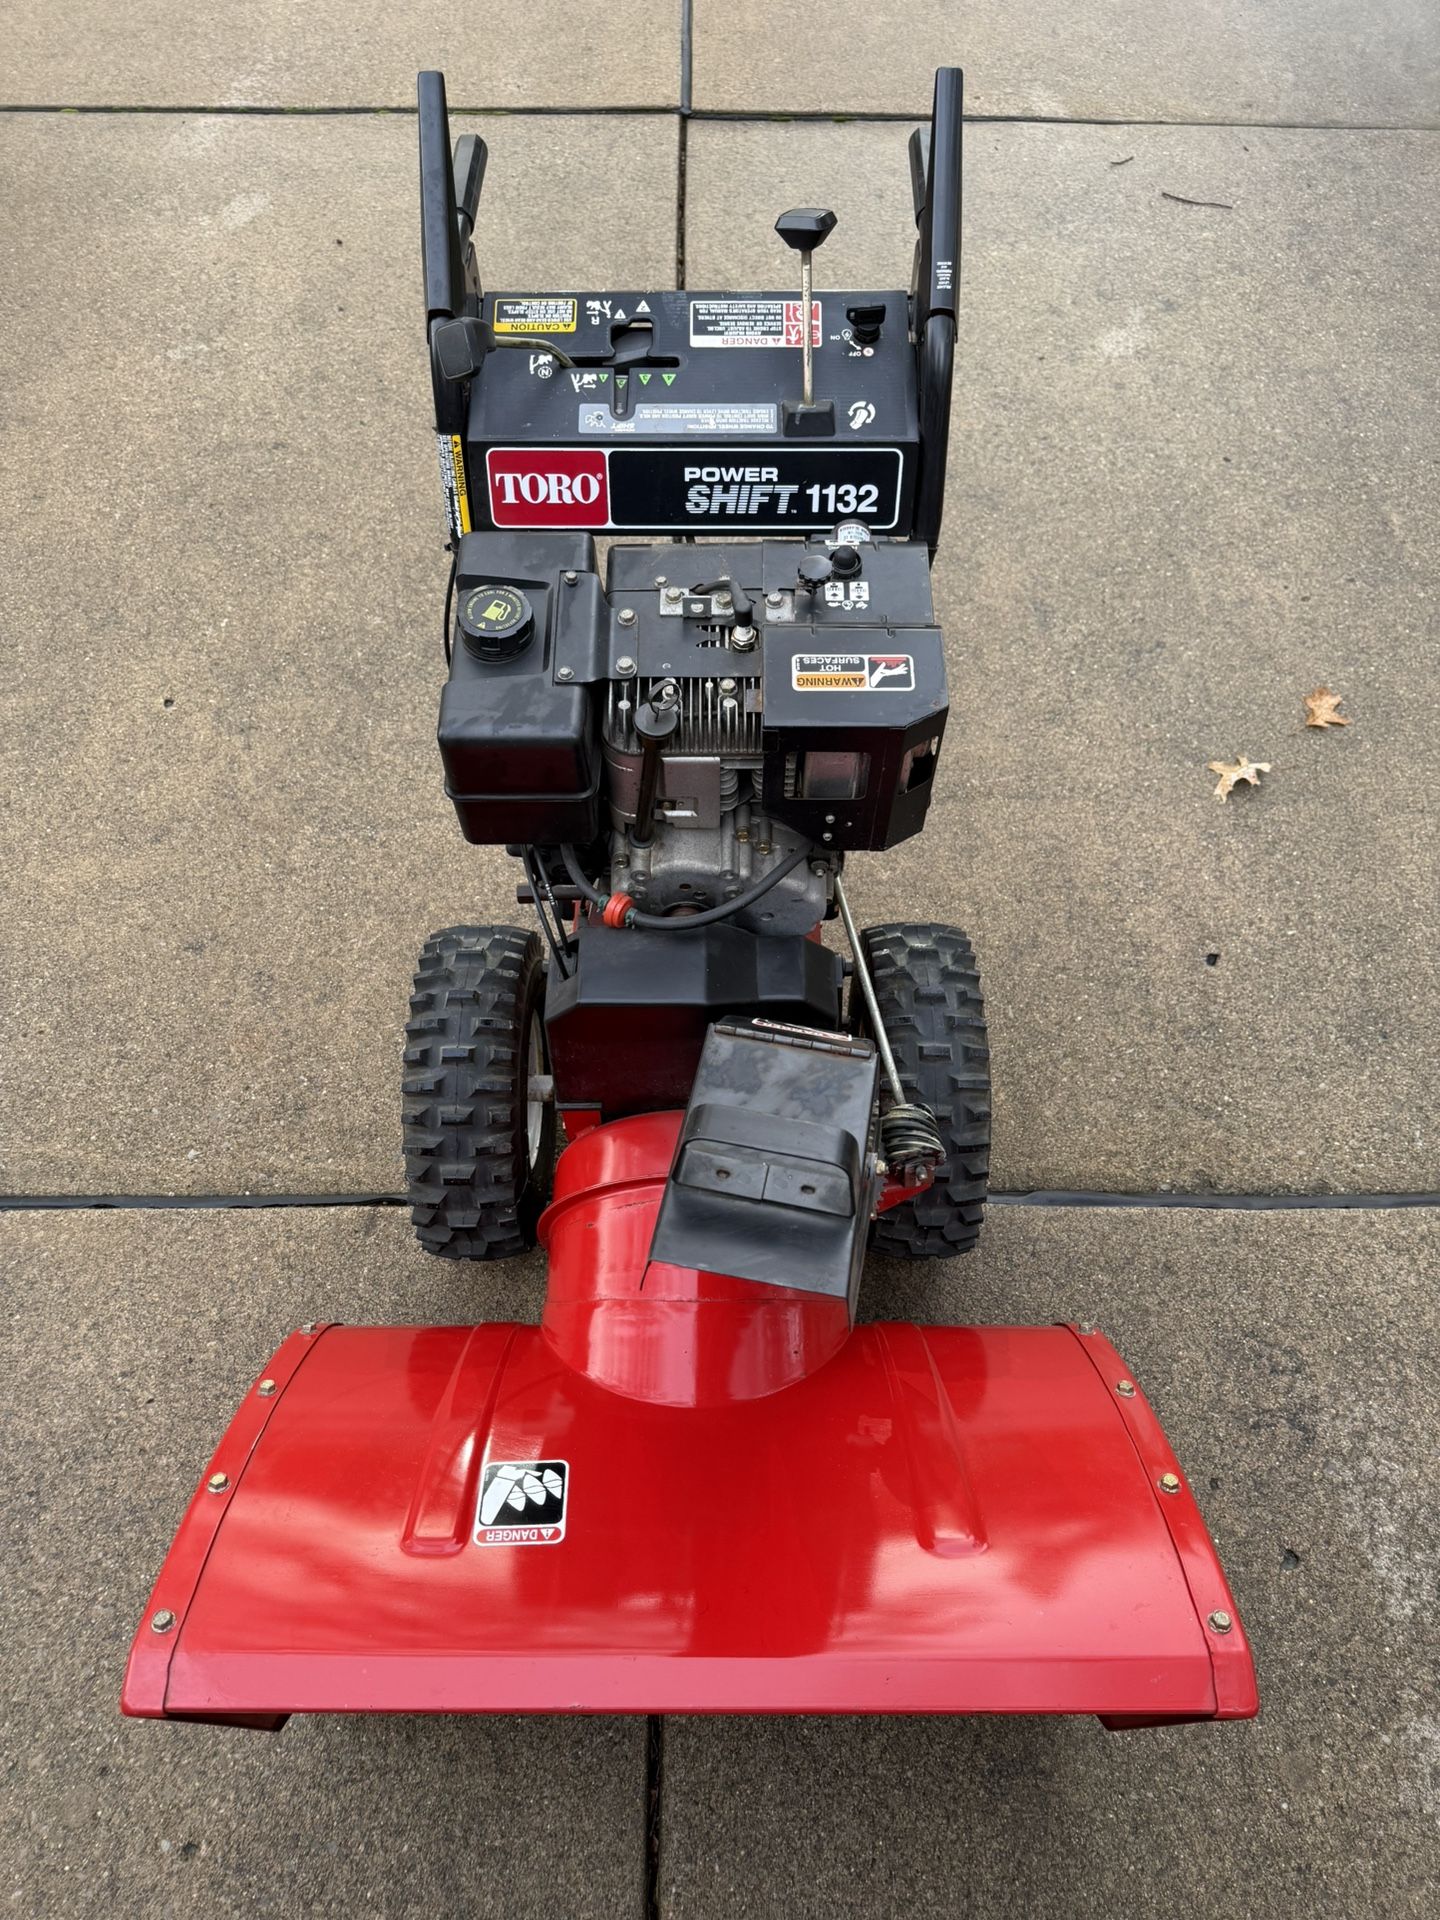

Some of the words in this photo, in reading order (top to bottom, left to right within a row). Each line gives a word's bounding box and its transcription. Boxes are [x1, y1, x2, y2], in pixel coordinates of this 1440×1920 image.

[590, 316, 601, 326] R
[510, 323, 560, 331] CAUTION
[721, 337, 768, 346] DANGER
[455, 450, 467, 497] WARNING
[683, 466, 779, 483] POWER
[805, 484, 878, 514] 1132
[803, 656, 860, 664] SURFACES
[820, 664, 842, 672] HOT
[796, 677, 852, 687] WARNING
[486, 1528, 539, 1542] DANGER
